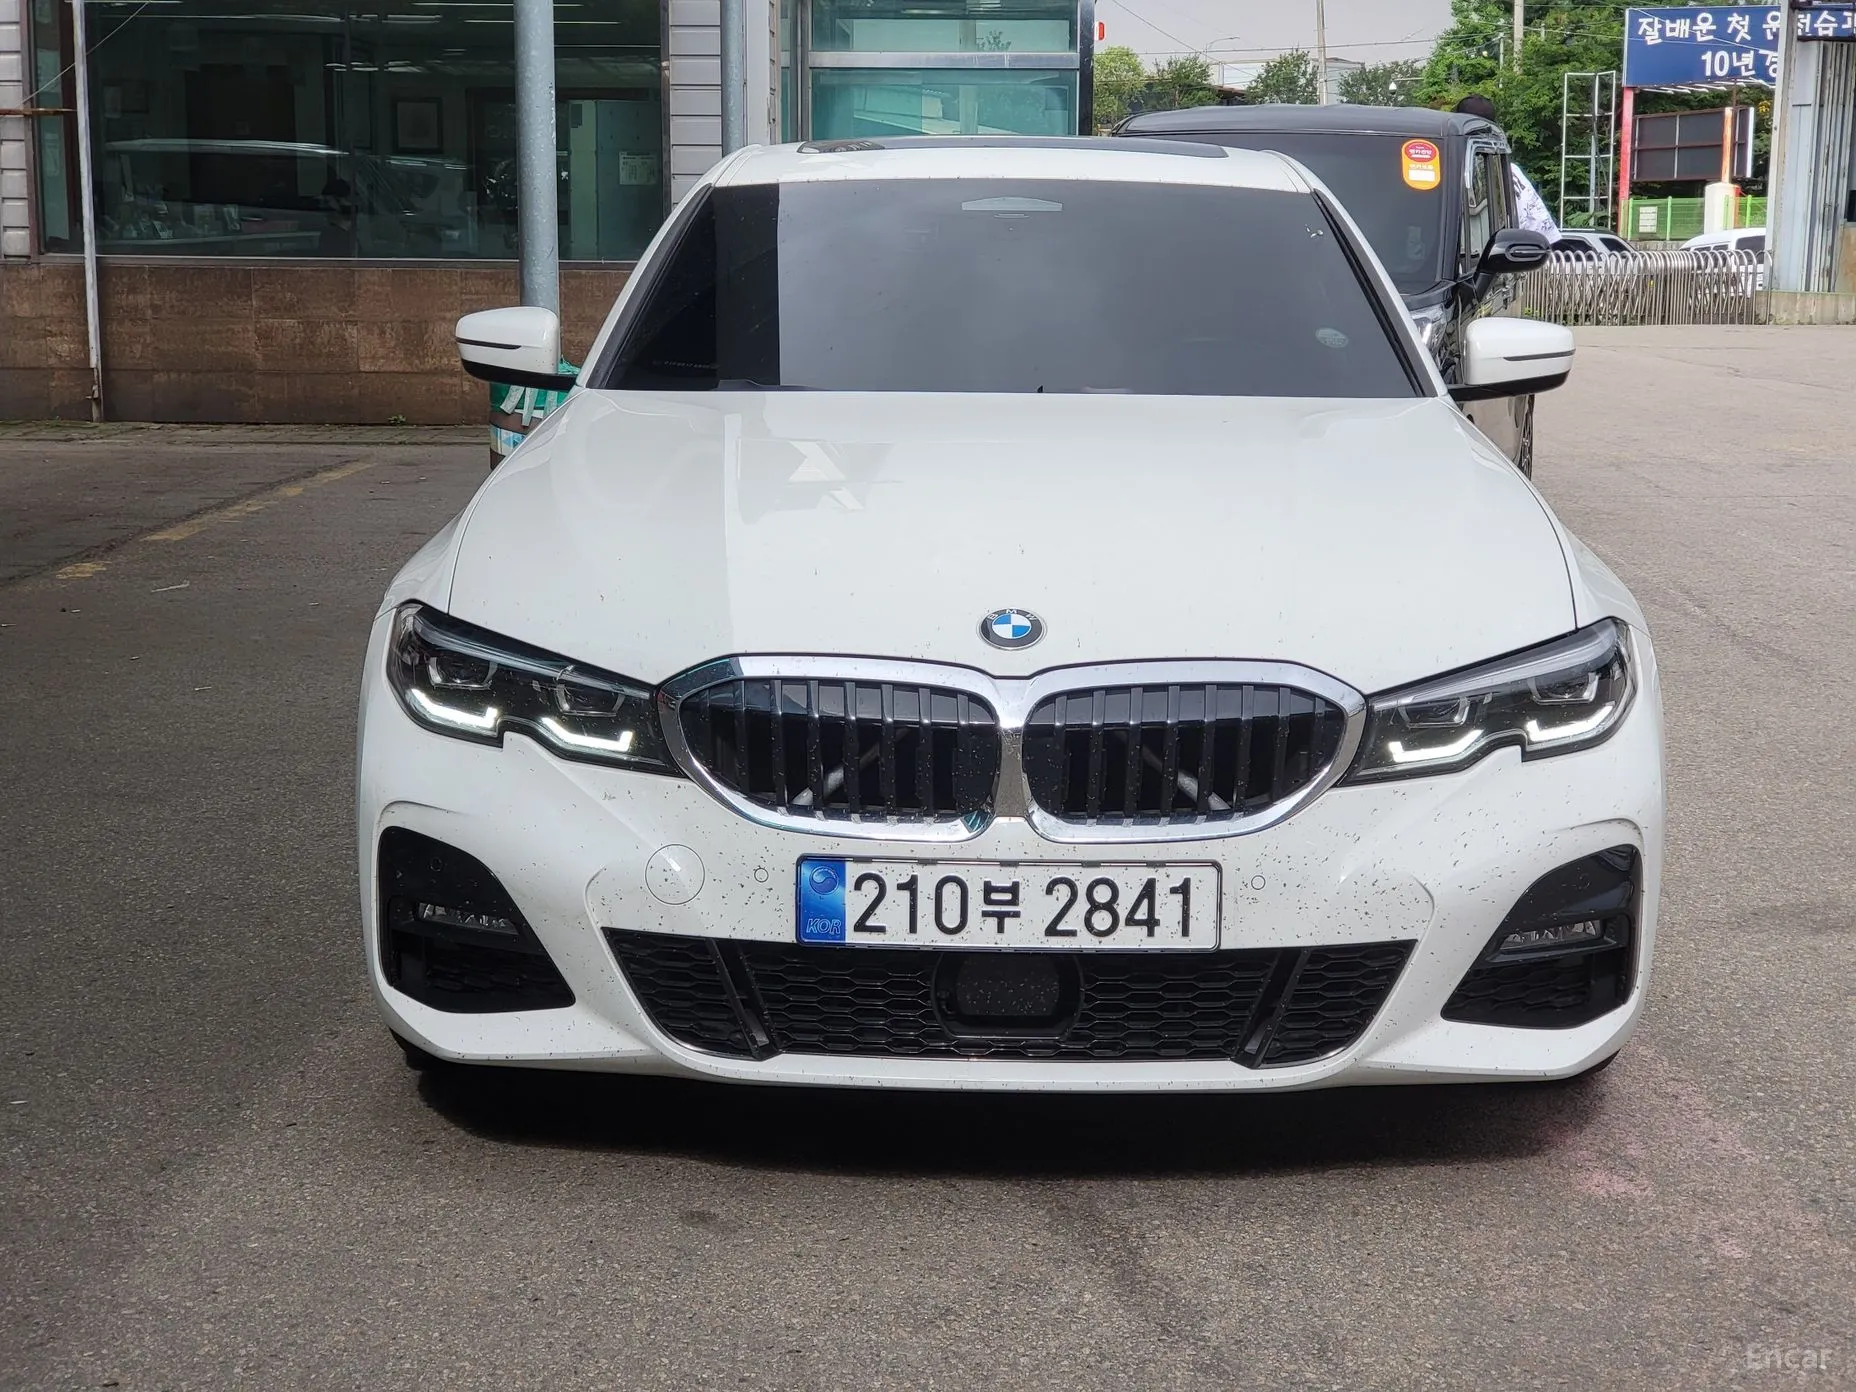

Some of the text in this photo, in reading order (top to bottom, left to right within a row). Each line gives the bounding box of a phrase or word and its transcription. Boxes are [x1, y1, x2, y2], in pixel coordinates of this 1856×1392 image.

[1638, 12, 1717, 45] 잘배운
[1727, 12, 1752, 43] 첫
[1701, 50, 1756, 77] 10년
[853, 872, 1191, 938] 210부 2841
[806, 918, 842, 936] KOR
